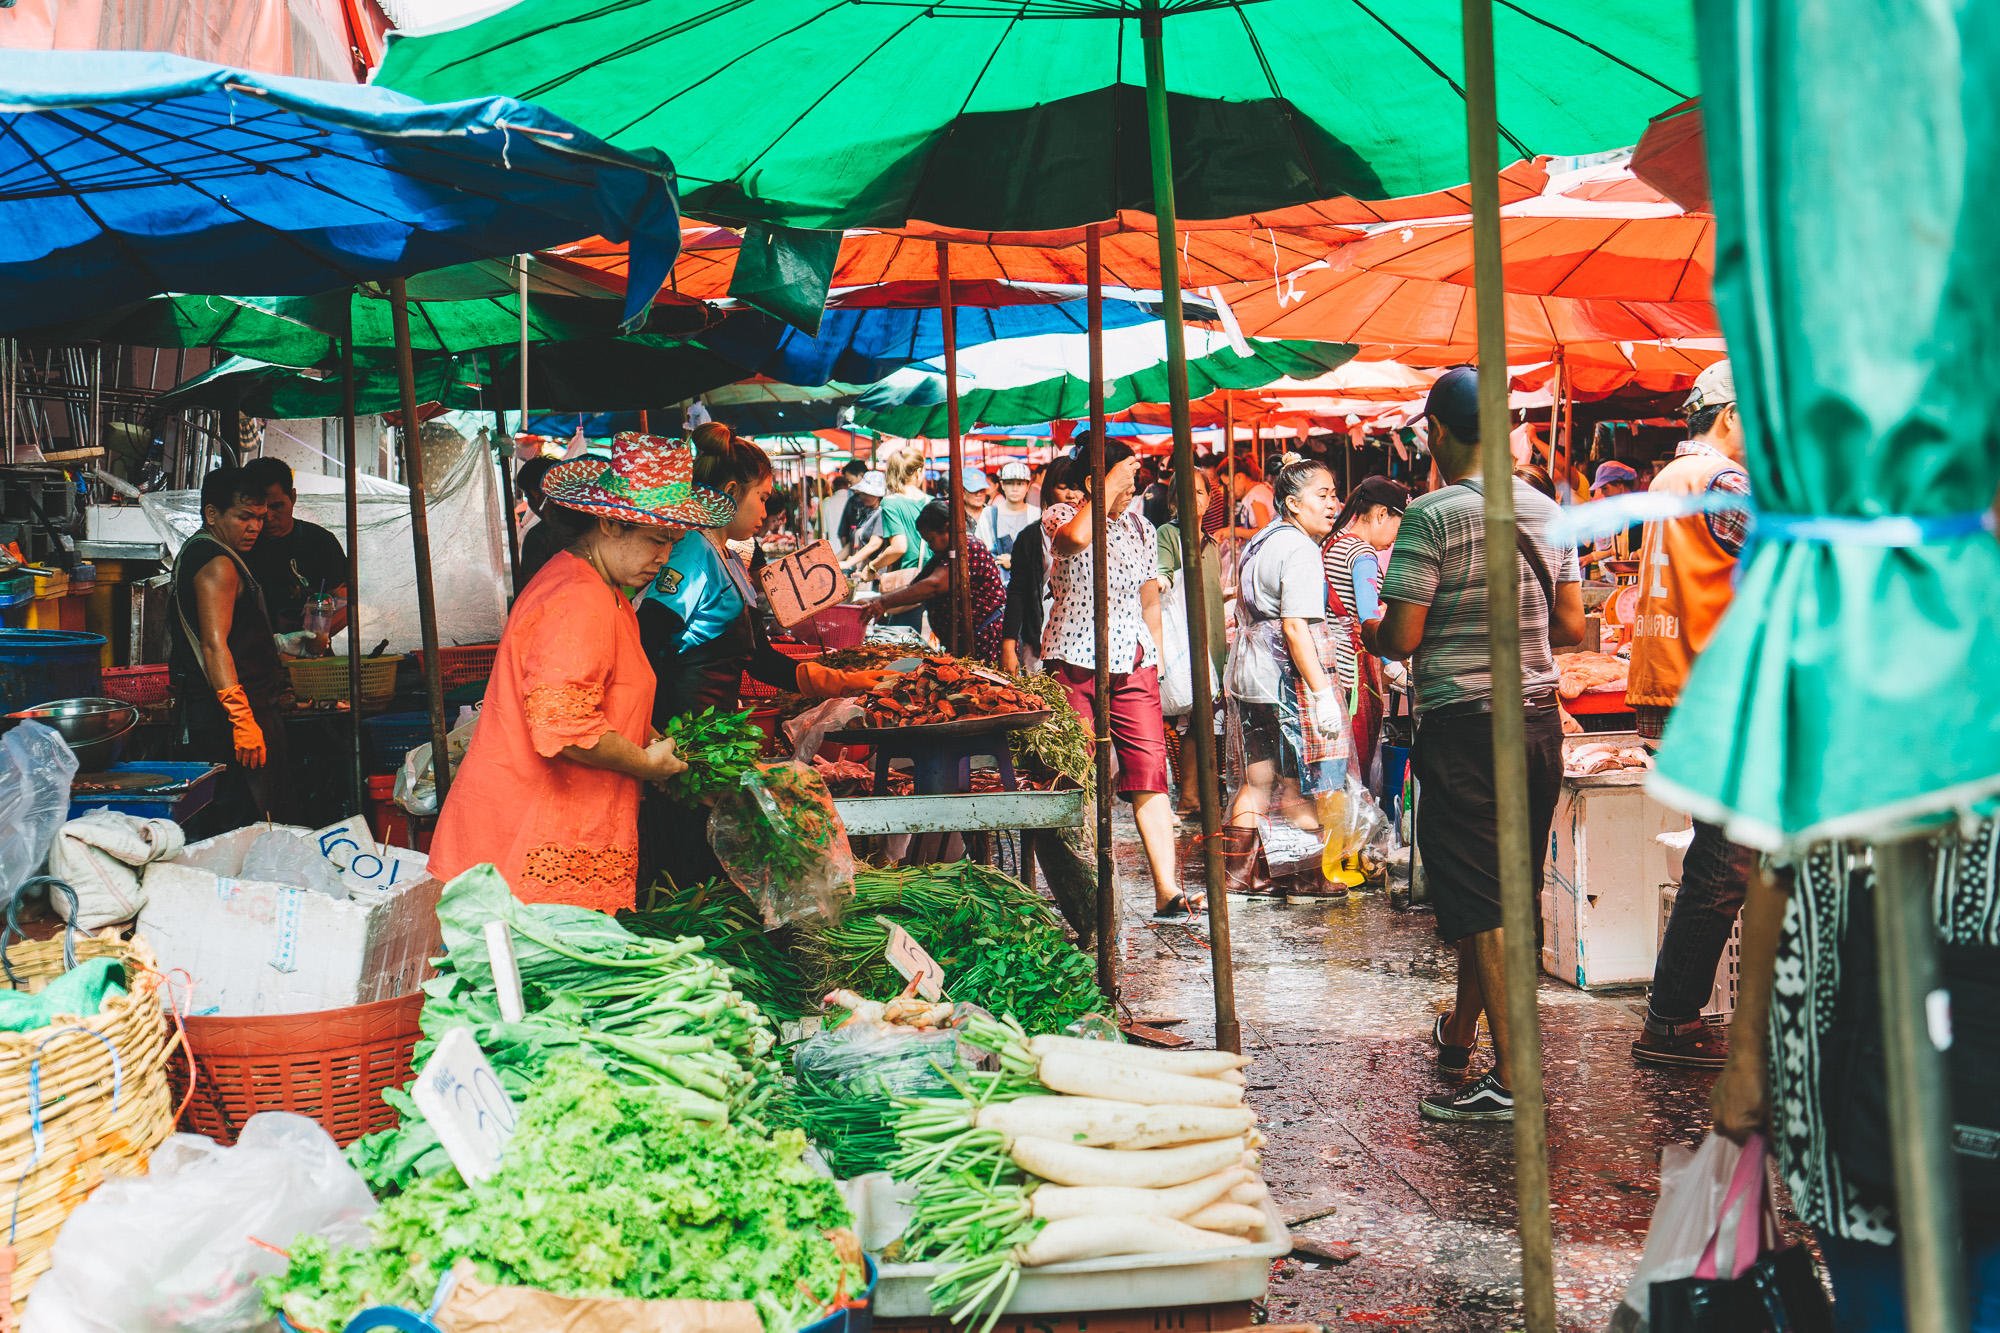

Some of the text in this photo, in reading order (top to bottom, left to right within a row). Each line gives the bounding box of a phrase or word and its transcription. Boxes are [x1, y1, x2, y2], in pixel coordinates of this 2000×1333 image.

[780, 541, 836, 611] 15
[902, 935, 934, 979] 5
[455, 1067, 516, 1162] 20
